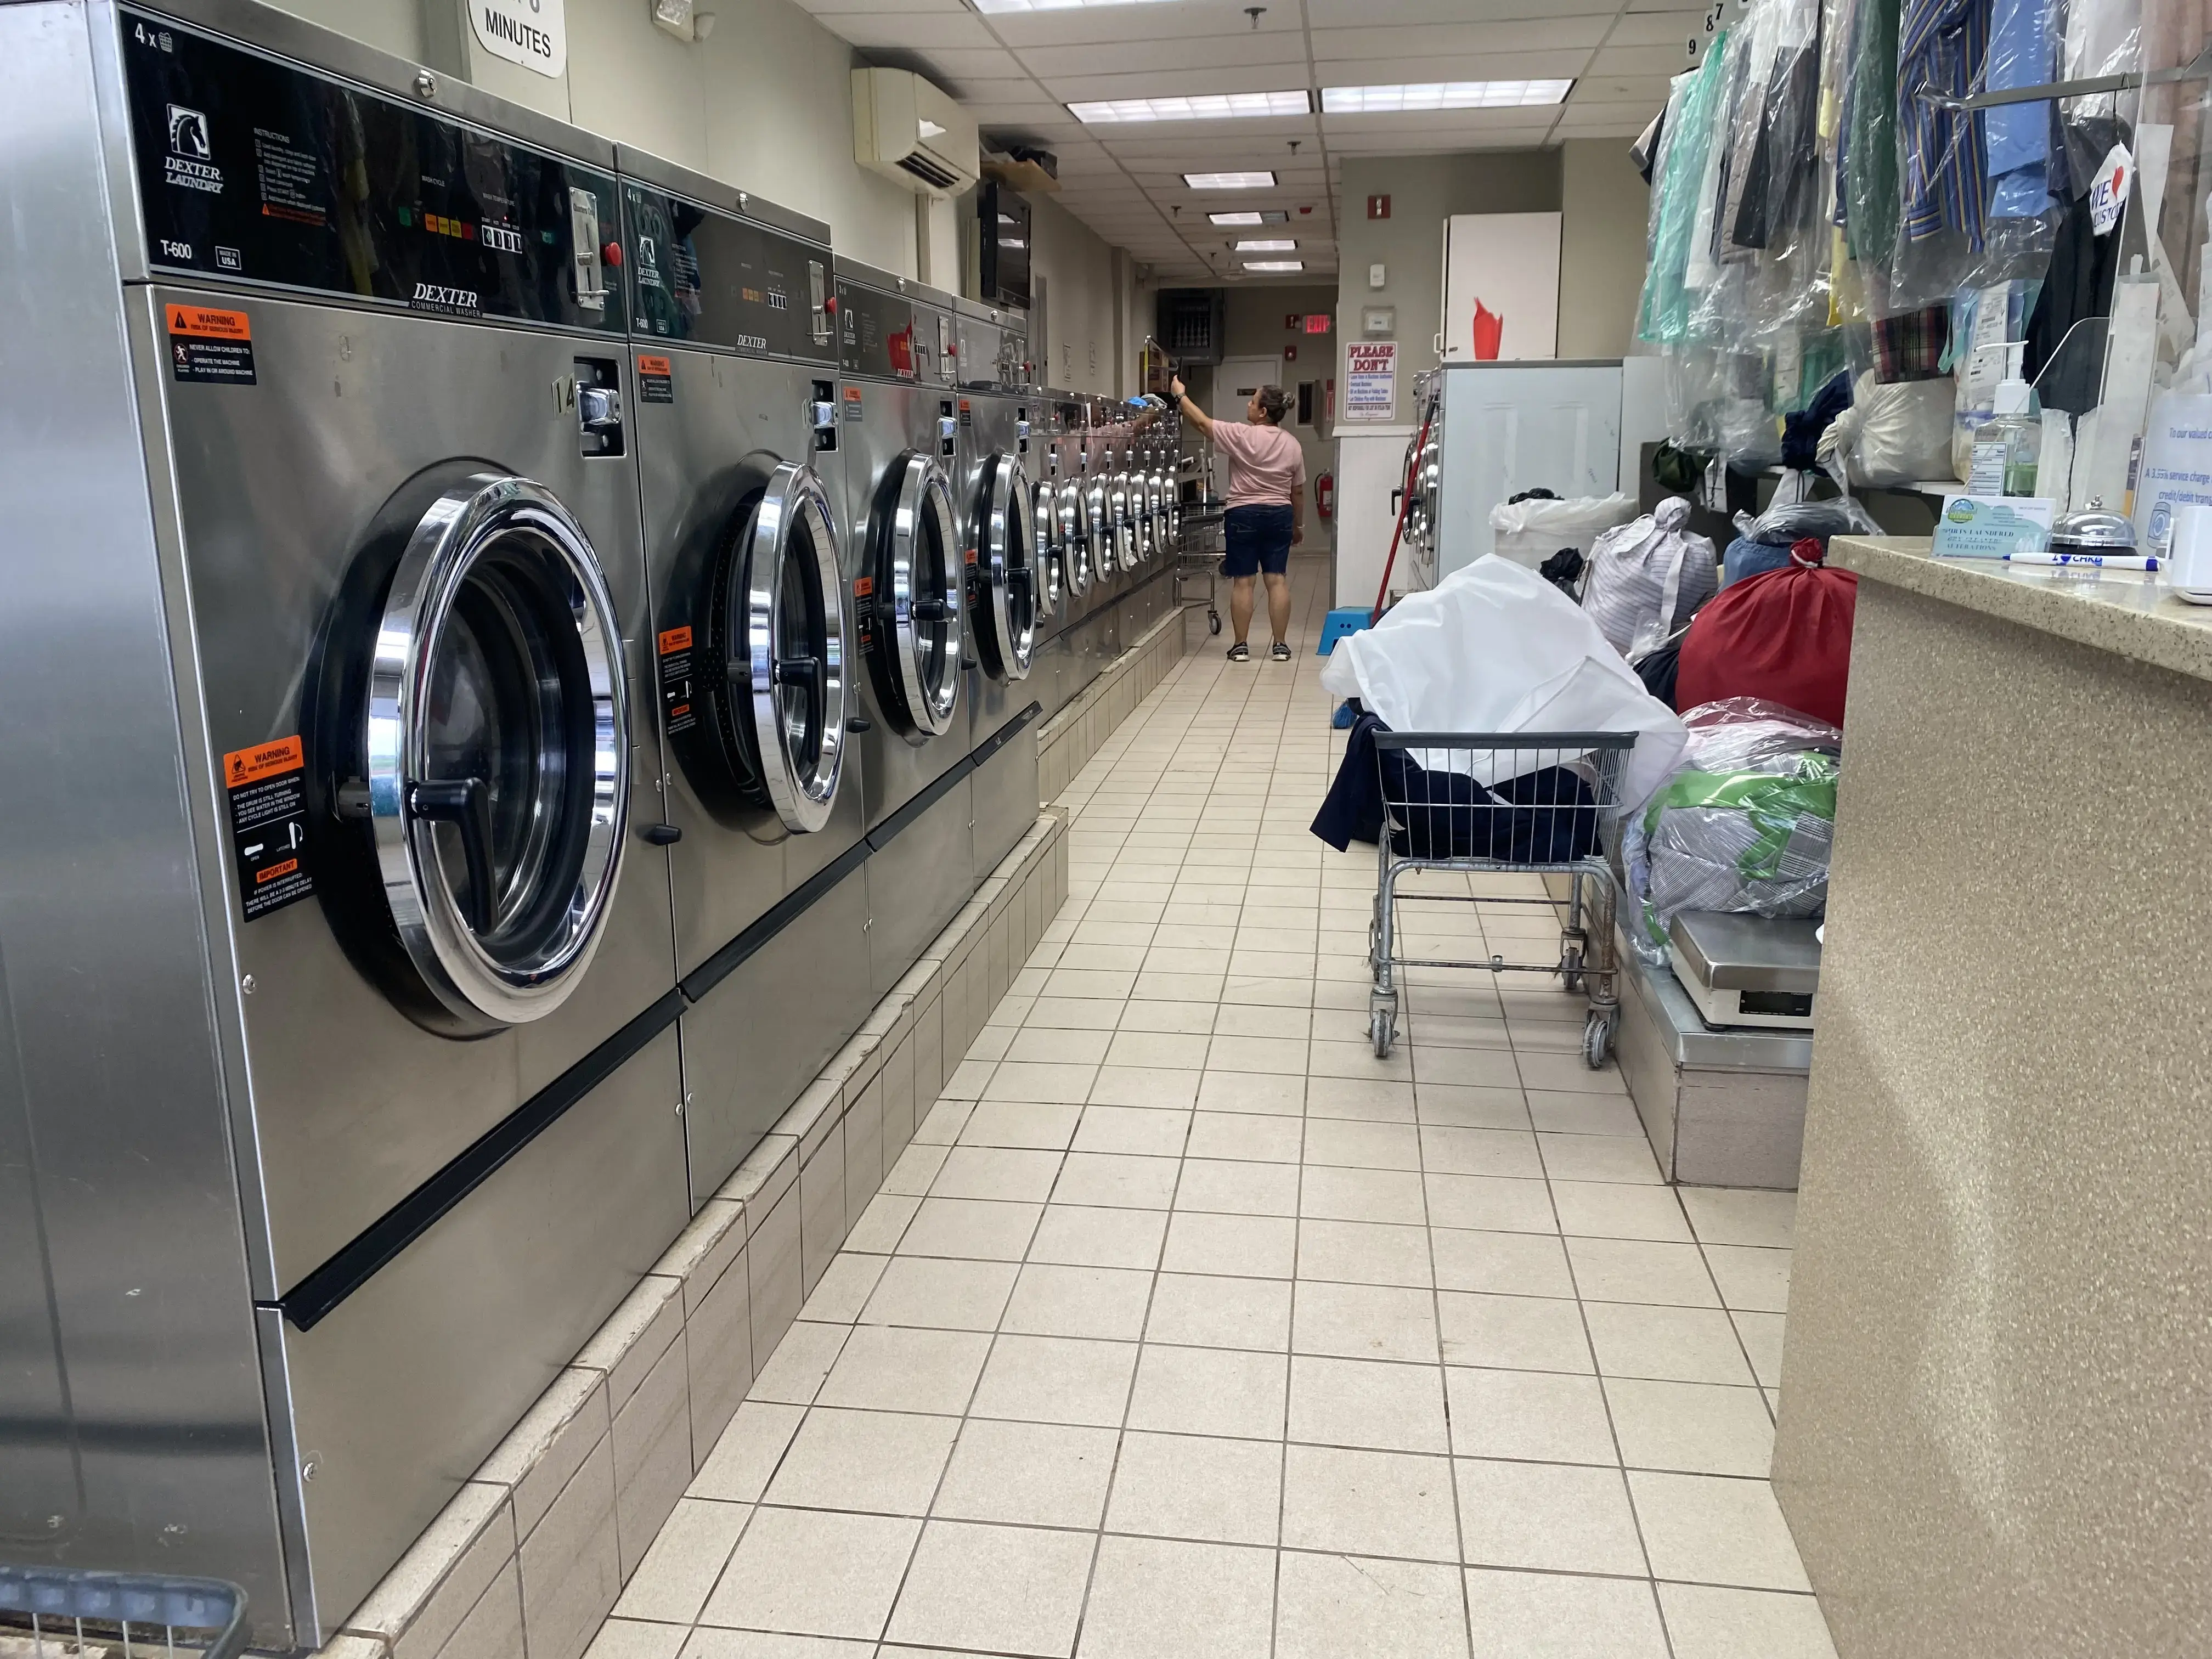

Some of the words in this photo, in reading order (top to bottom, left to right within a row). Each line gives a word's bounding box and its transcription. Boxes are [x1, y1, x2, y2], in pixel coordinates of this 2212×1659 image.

[1716, 3, 1723, 20] 7
[1706, 14, 1714, 31] 8
[135, 23, 145, 44] 4
[148, 33, 157, 48] x
[485, 7, 551, 58] MINUTES
[1689, 40, 1696, 54] 9
[164, 156, 221, 180] DEXTER
[166, 172, 223, 194] LAUNDRY
[627, 188, 631, 201] 4
[2091, 179, 2111, 211] WE
[160, 239, 191, 259] T-600
[222, 256, 236, 266] USA
[638, 267, 659, 279] DEXTER
[413, 283, 477, 308] DEXTER
[411, 300, 454, 314] COMMERCIAL
[455, 307, 481, 318] WASHER
[198, 313, 235, 326] WARNING
[636, 318, 648, 329] T-600
[737, 334, 766, 349] DEXTER
[1350, 346, 1394, 358] PLEASE
[897, 368, 914, 379] DEXTER
[1353, 359, 1389, 371] DON'T
[556, 378, 574, 414] 14
[2170, 427, 2176, 438] To
[2177, 430, 2187, 438] our
[2188, 427, 2208, 439] valued
[2145, 468, 2149, 478] A
[2169, 471, 2188, 481] service
[2190, 471, 2210, 486] charge
[2159, 490, 2193, 503] credit/debit
[255, 746, 290, 764] WARNING
[264, 782, 275, 792] OPEN
[246, 798, 258, 807] DRUM
[274, 788, 291, 798] TURNING
[256, 803, 270, 811] WATER
[284, 793, 300, 802] WINDOW
[248, 812, 261, 821] CYCLE
[262, 809, 273, 817] LIGHT
[259, 861, 295, 880] IMPORTANT
[246, 898, 259, 907] THERE
[285, 882, 299, 891] MINUTE
[300, 877, 312, 885] DELAY
[258, 884, 272, 894] POWER
[247, 904, 263, 913] BEFORE
[272, 895, 283, 904] DOOR
[297, 884, 312, 894] OPENED
